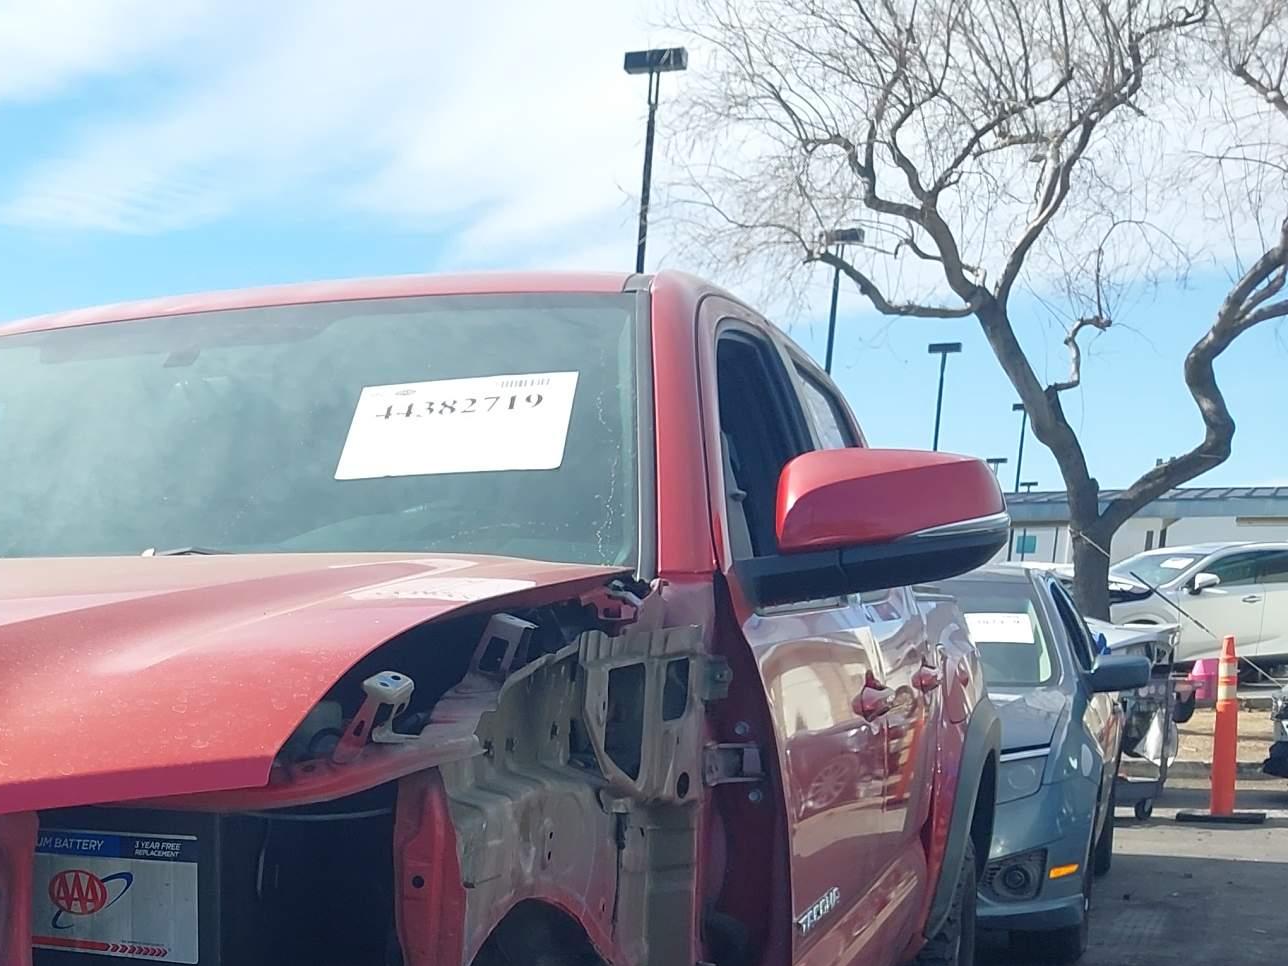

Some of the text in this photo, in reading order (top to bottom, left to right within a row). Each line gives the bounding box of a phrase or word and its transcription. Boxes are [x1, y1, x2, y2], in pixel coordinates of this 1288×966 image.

[376, 392, 545, 420] 44382719
[54, 837, 104, 851] BATTERY
[134, 840, 182, 851] 3 YEAR FREE
[134, 849, 180, 858] REPLACEMENT
[52, 870, 104, 914] AAA
